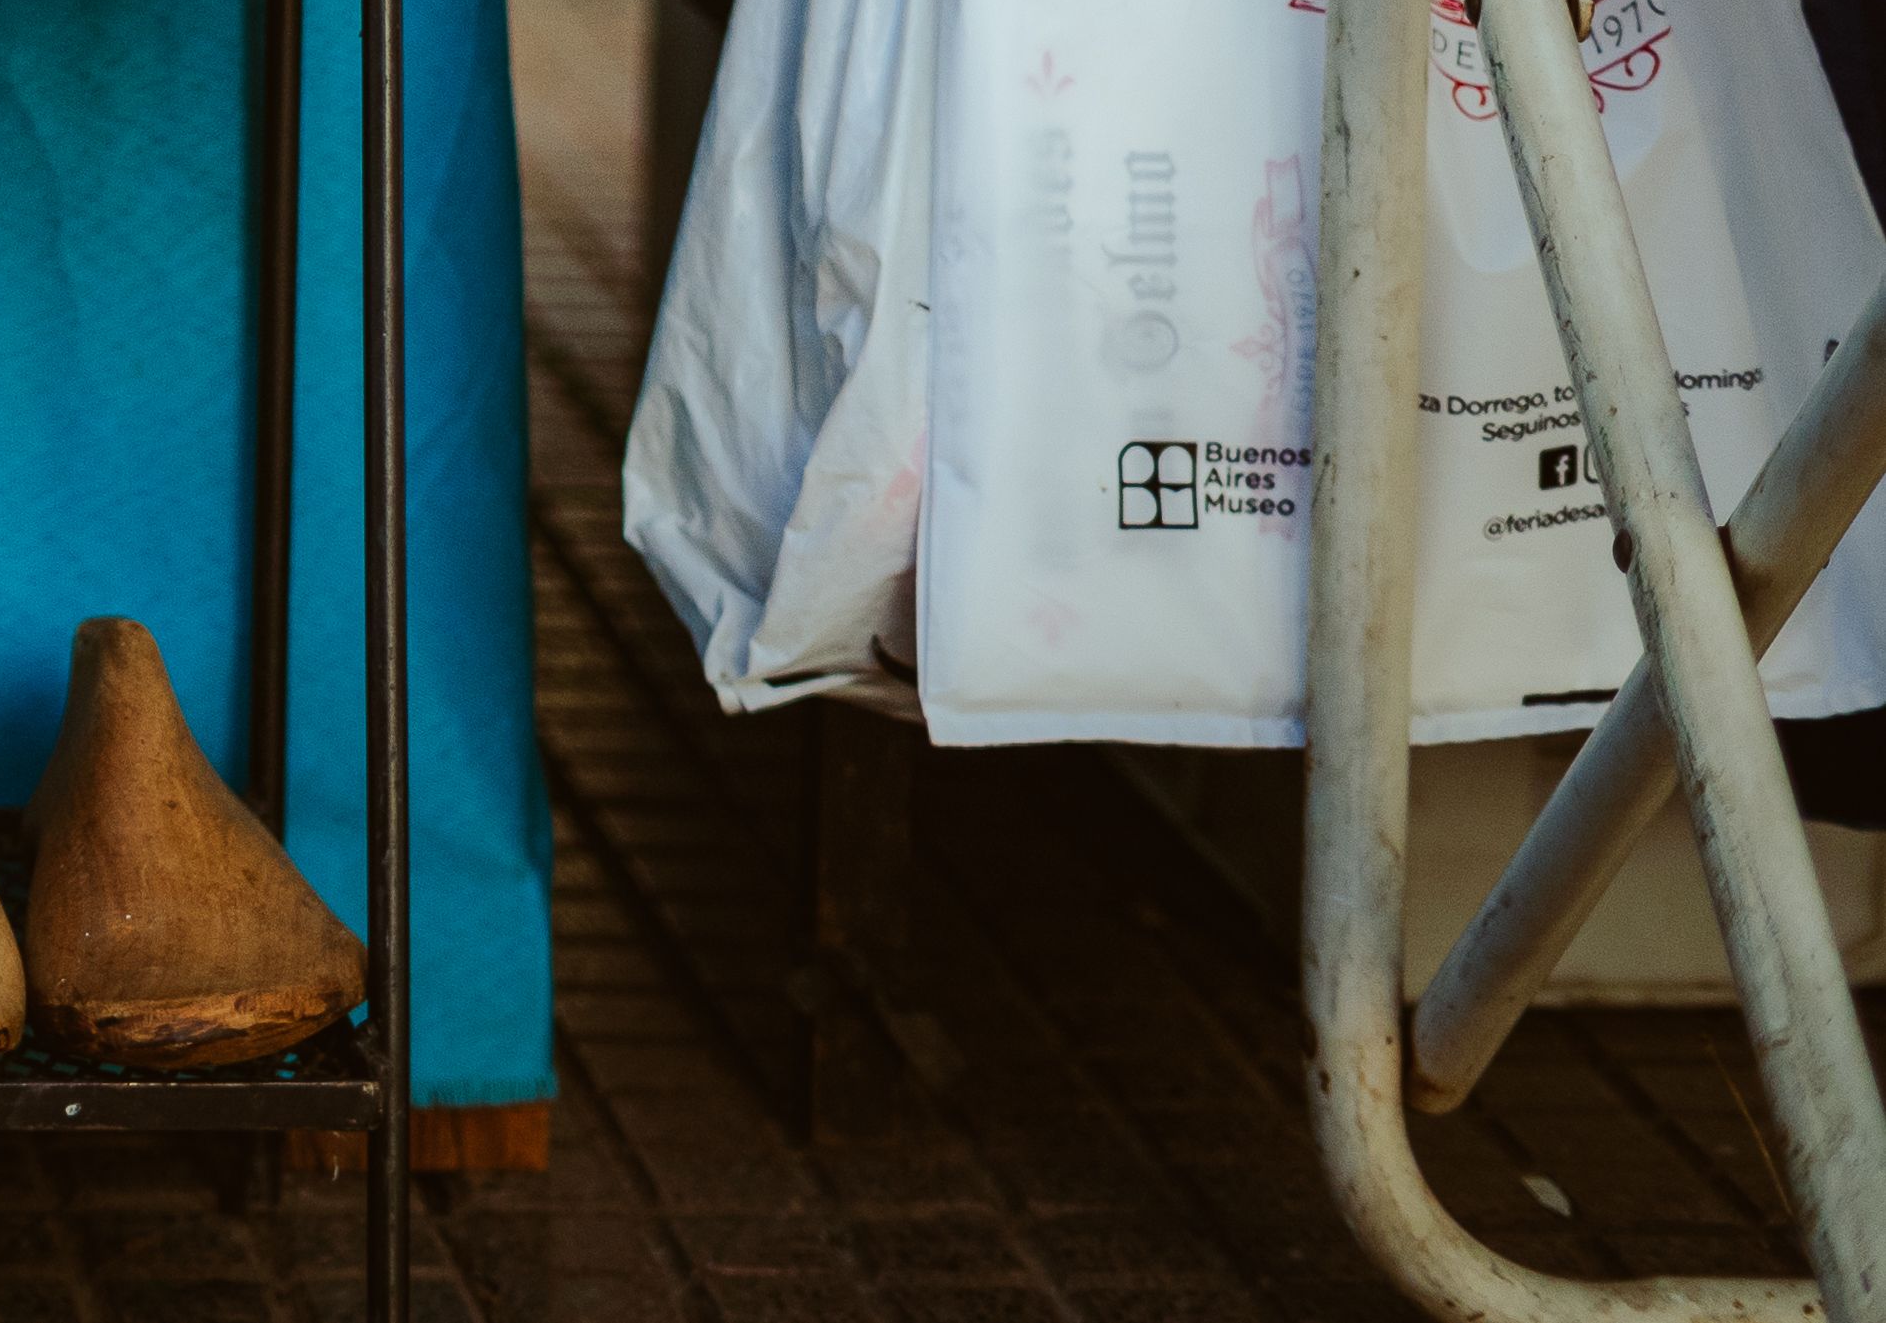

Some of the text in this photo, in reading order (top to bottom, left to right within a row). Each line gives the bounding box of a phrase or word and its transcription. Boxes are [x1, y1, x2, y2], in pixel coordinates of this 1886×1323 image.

[1447, 387, 1548, 417] Dorrego,
[1481, 411, 1581, 443] Seguinos
[1204, 441, 1312, 468] Buenos
[1204, 467, 1276, 490] Aires
[1204, 493, 1296, 517] Museo
